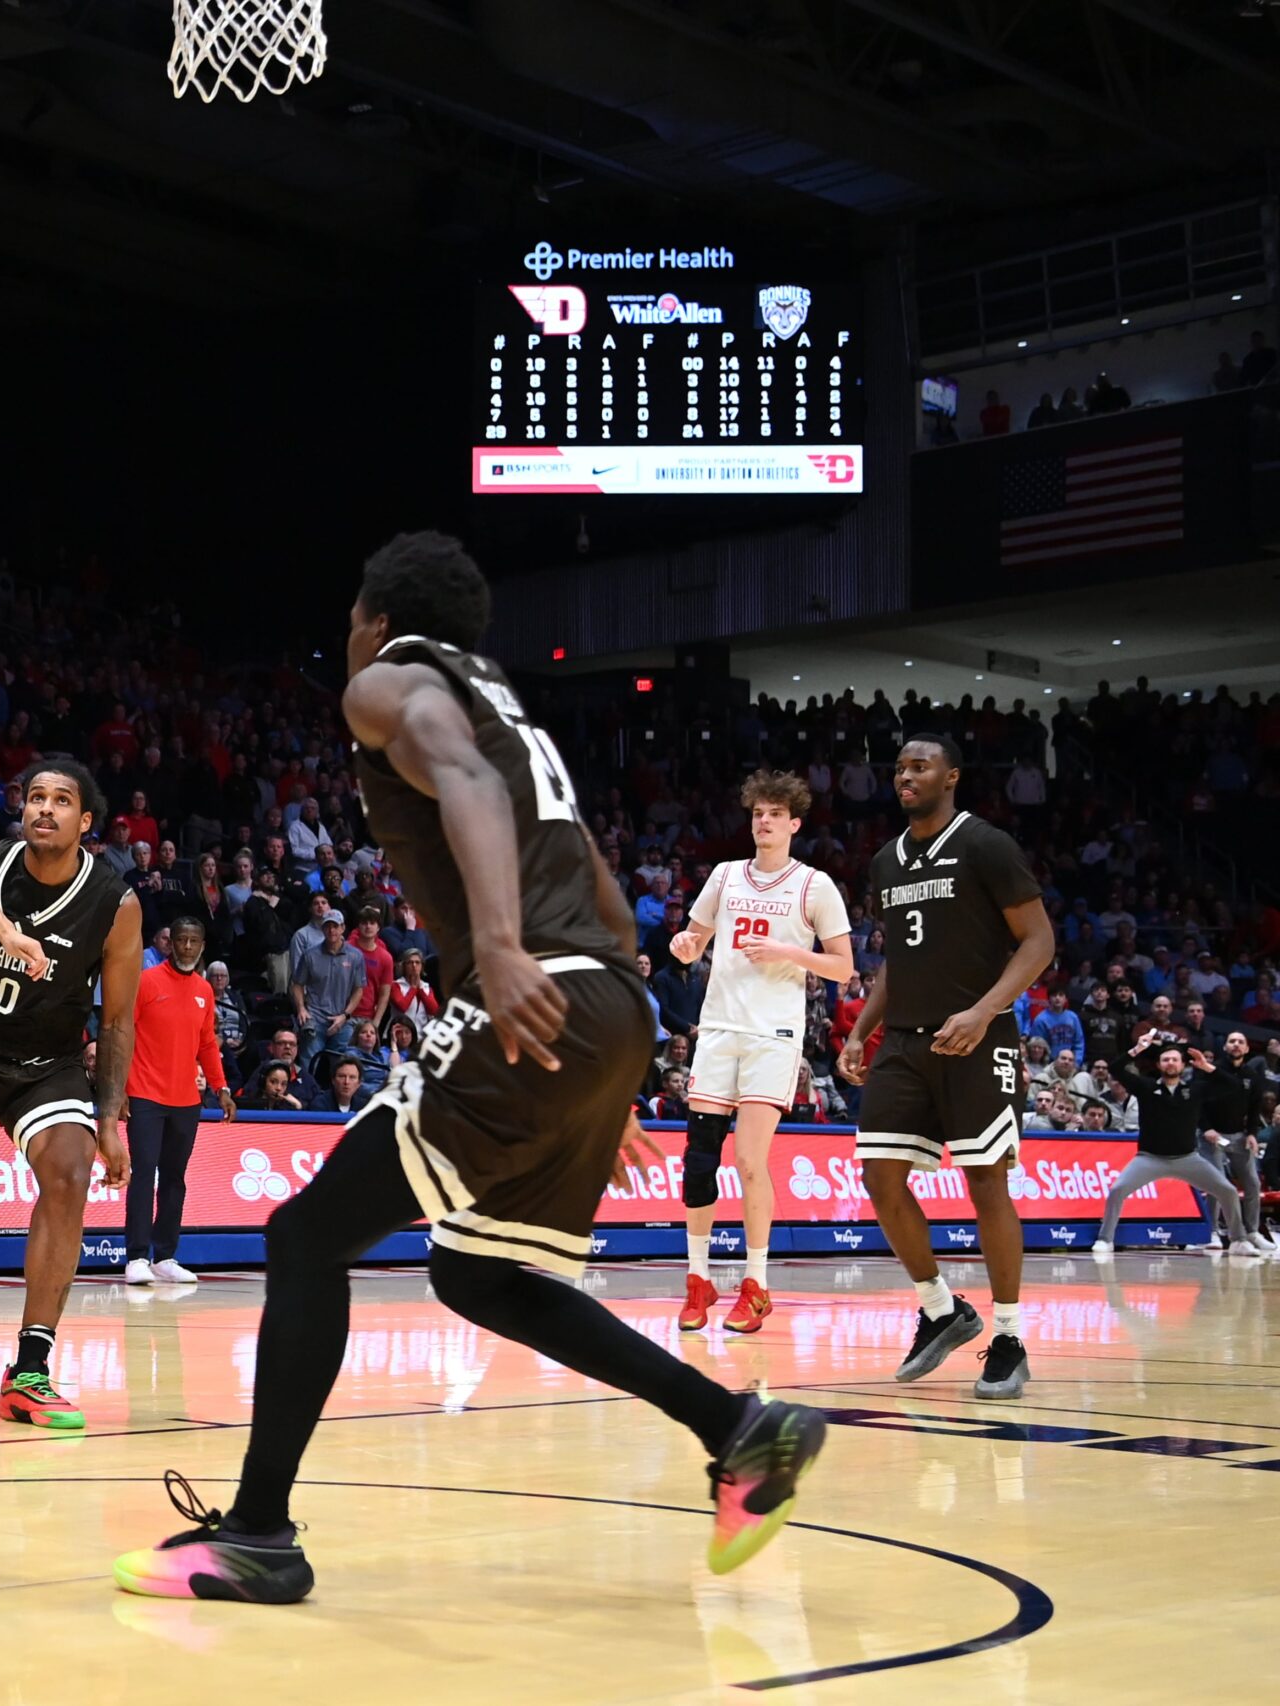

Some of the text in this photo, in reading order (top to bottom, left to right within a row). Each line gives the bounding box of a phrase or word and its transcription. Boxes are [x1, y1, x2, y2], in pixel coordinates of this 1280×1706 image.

[568, 247, 734, 269] Premier Health
[759, 285, 812, 307] BONNIES
[527, 333, 541, 350] P
[568, 334, 582, 350] R
[602, 333, 617, 350] A
[642, 333, 655, 350] F
[721, 332, 735, 349] P
[762, 331, 776, 348] R
[797, 331, 812, 348] A
[837, 330, 851, 348] F
[490, 357, 503, 372] 0
[566, 357, 578, 372] 3
[601, 356, 611, 372] 1
[637, 356, 647, 371] 1
[681, 355, 842, 371] 00 14 11 0 4
[637, 373, 647, 388] 1
[719, 372, 740, 388] 10
[795, 372, 805, 387] 1
[490, 393, 503, 408] 4
[719, 390, 740, 405] 14
[760, 390, 770, 405] 1
[795, 389, 808, 404] 4
[490, 408, 502, 423] 7
[601, 407, 614, 422] 0
[637, 407, 650, 422] 0
[719, 406, 739, 421] 17
[760, 406, 770, 421] 1
[601, 424, 611, 439] 1
[719, 422, 740, 437] 13
[795, 422, 805, 437] 1
[829, 422, 842, 437] 4
[655, 467, 800, 480] UNIVERSITY OF DAYTON ATHLETICS
[891, 877, 955, 907] BONAVENTURE
[727, 896, 792, 917] DAYTON
[731, 916, 770, 950] 29
[906, 909, 924, 947] 3
